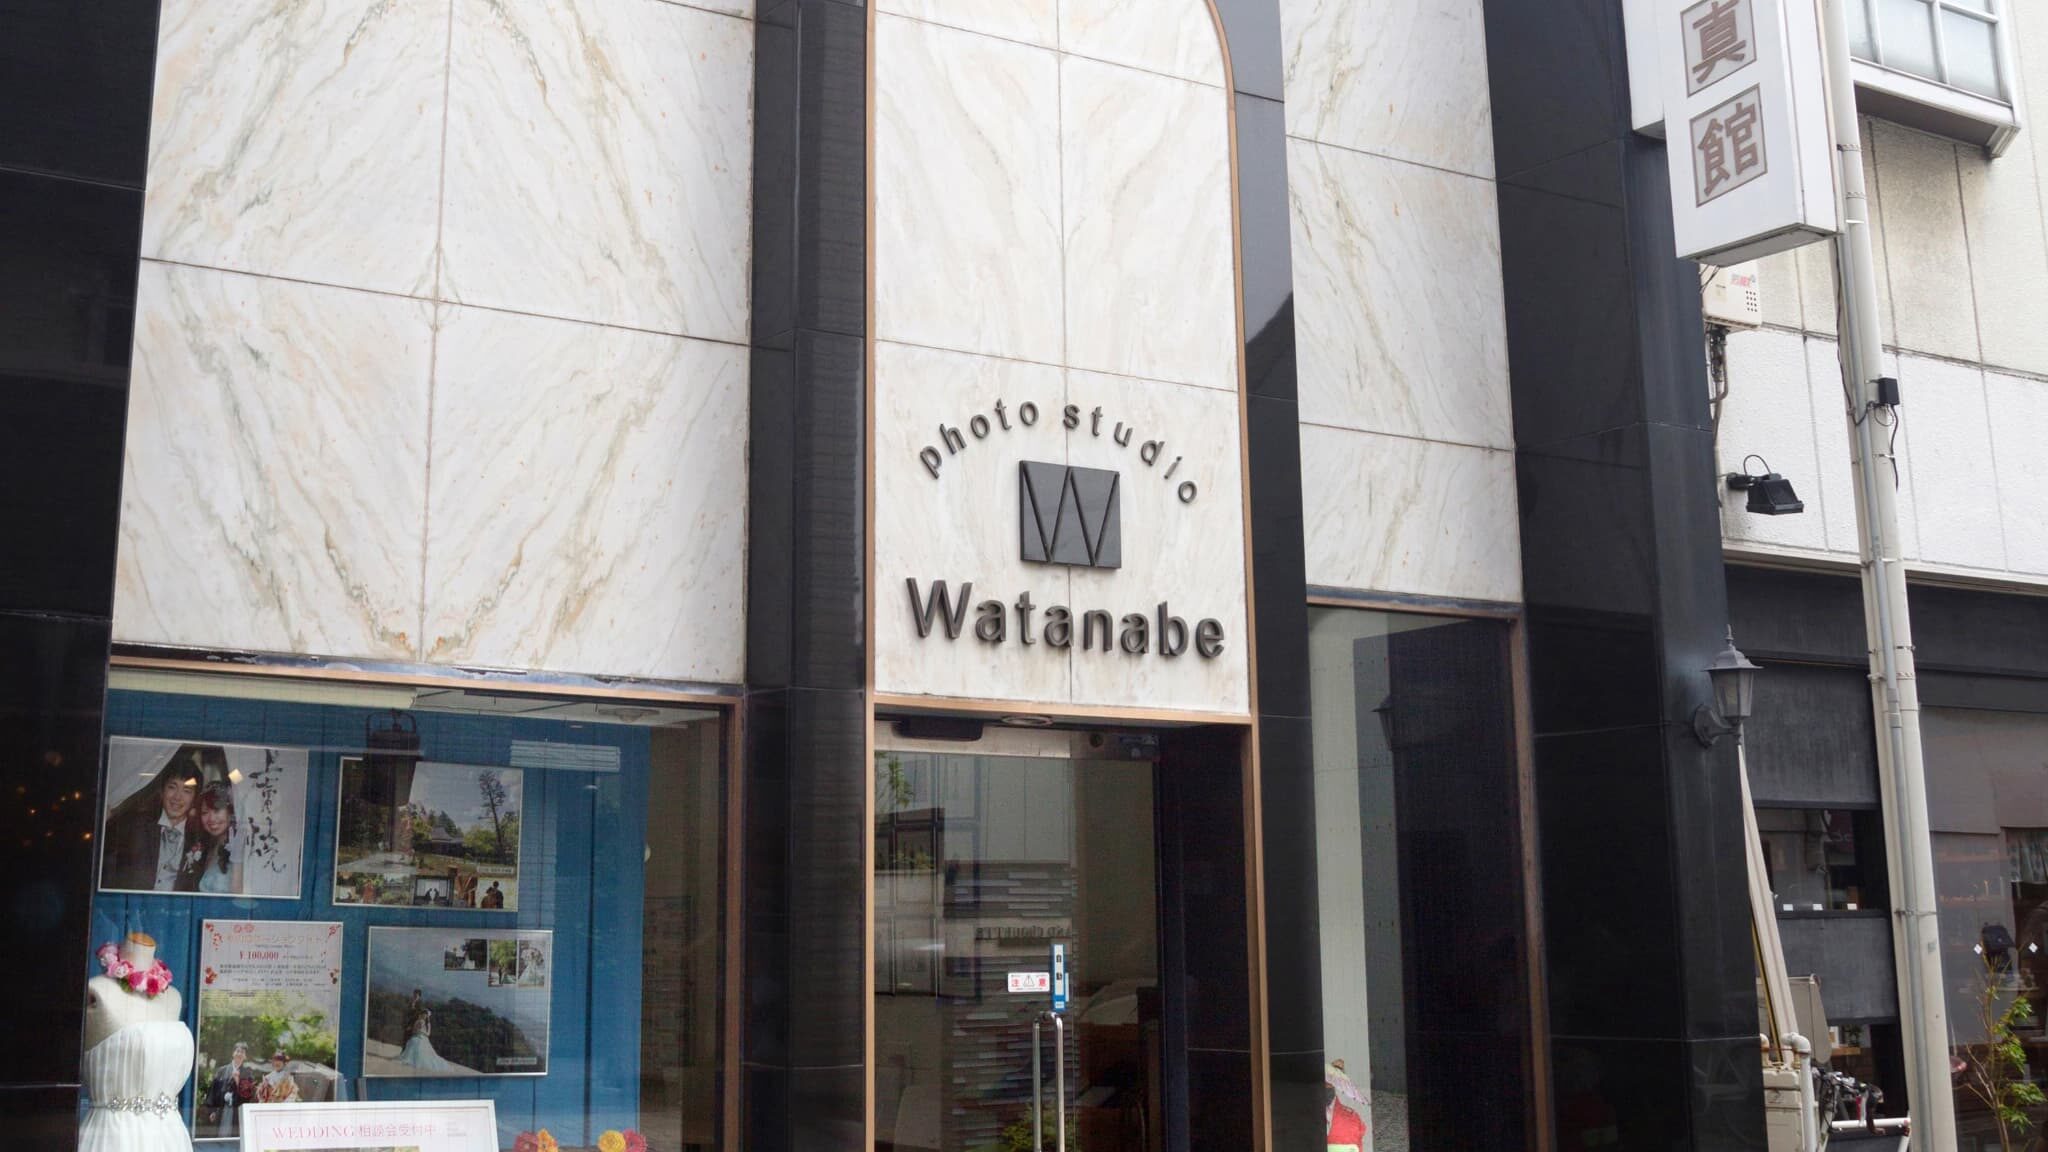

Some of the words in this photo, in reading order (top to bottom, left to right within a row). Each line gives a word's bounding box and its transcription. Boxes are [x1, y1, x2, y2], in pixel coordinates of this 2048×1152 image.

[919, 398, 1039, 479] photo
[1063, 403, 1198, 503] studio
[906, 577, 1225, 658] Watanabe
[273, 1127, 354, 1140] WEDDING
